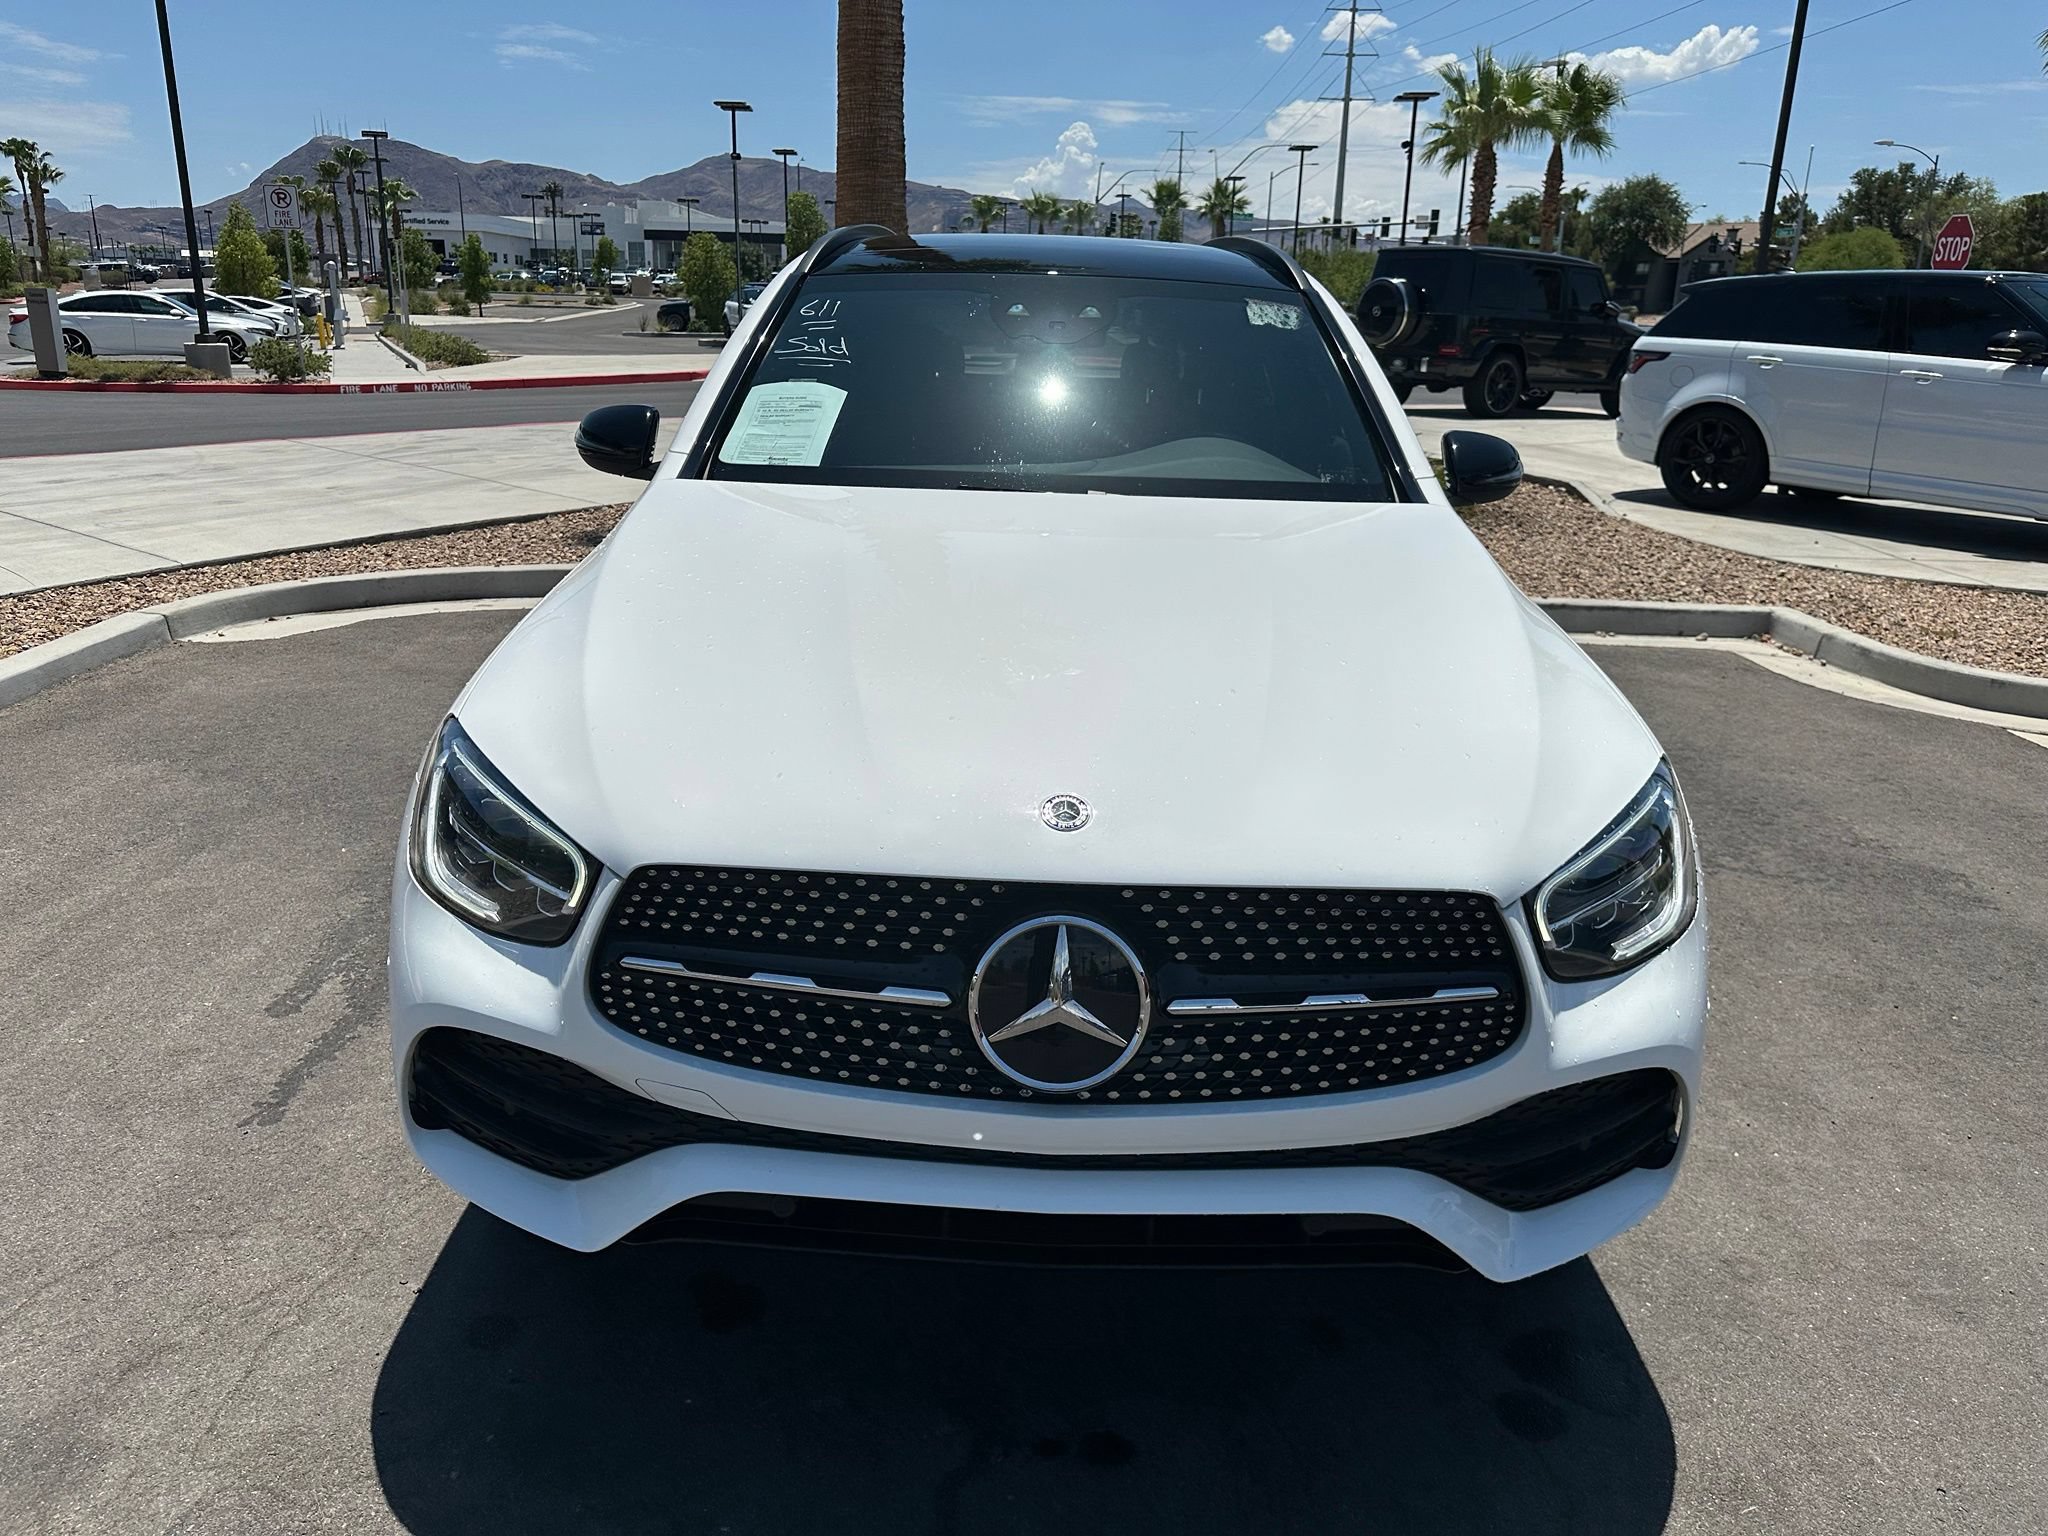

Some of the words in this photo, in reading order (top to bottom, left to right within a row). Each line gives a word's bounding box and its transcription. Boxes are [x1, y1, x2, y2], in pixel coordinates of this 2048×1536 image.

[274, 210, 291, 218] FIRE
[274, 219, 294, 227] LANE
[1935, 236, 1970, 262] STOP
[800, 299, 841, 316] 611
[774, 336, 849, 356] Sold
[340, 385, 361, 394] FIRE
[373, 384, 399, 393] LANE
[414, 383, 428, 392] NO
[432, 382, 472, 392] PARKING
